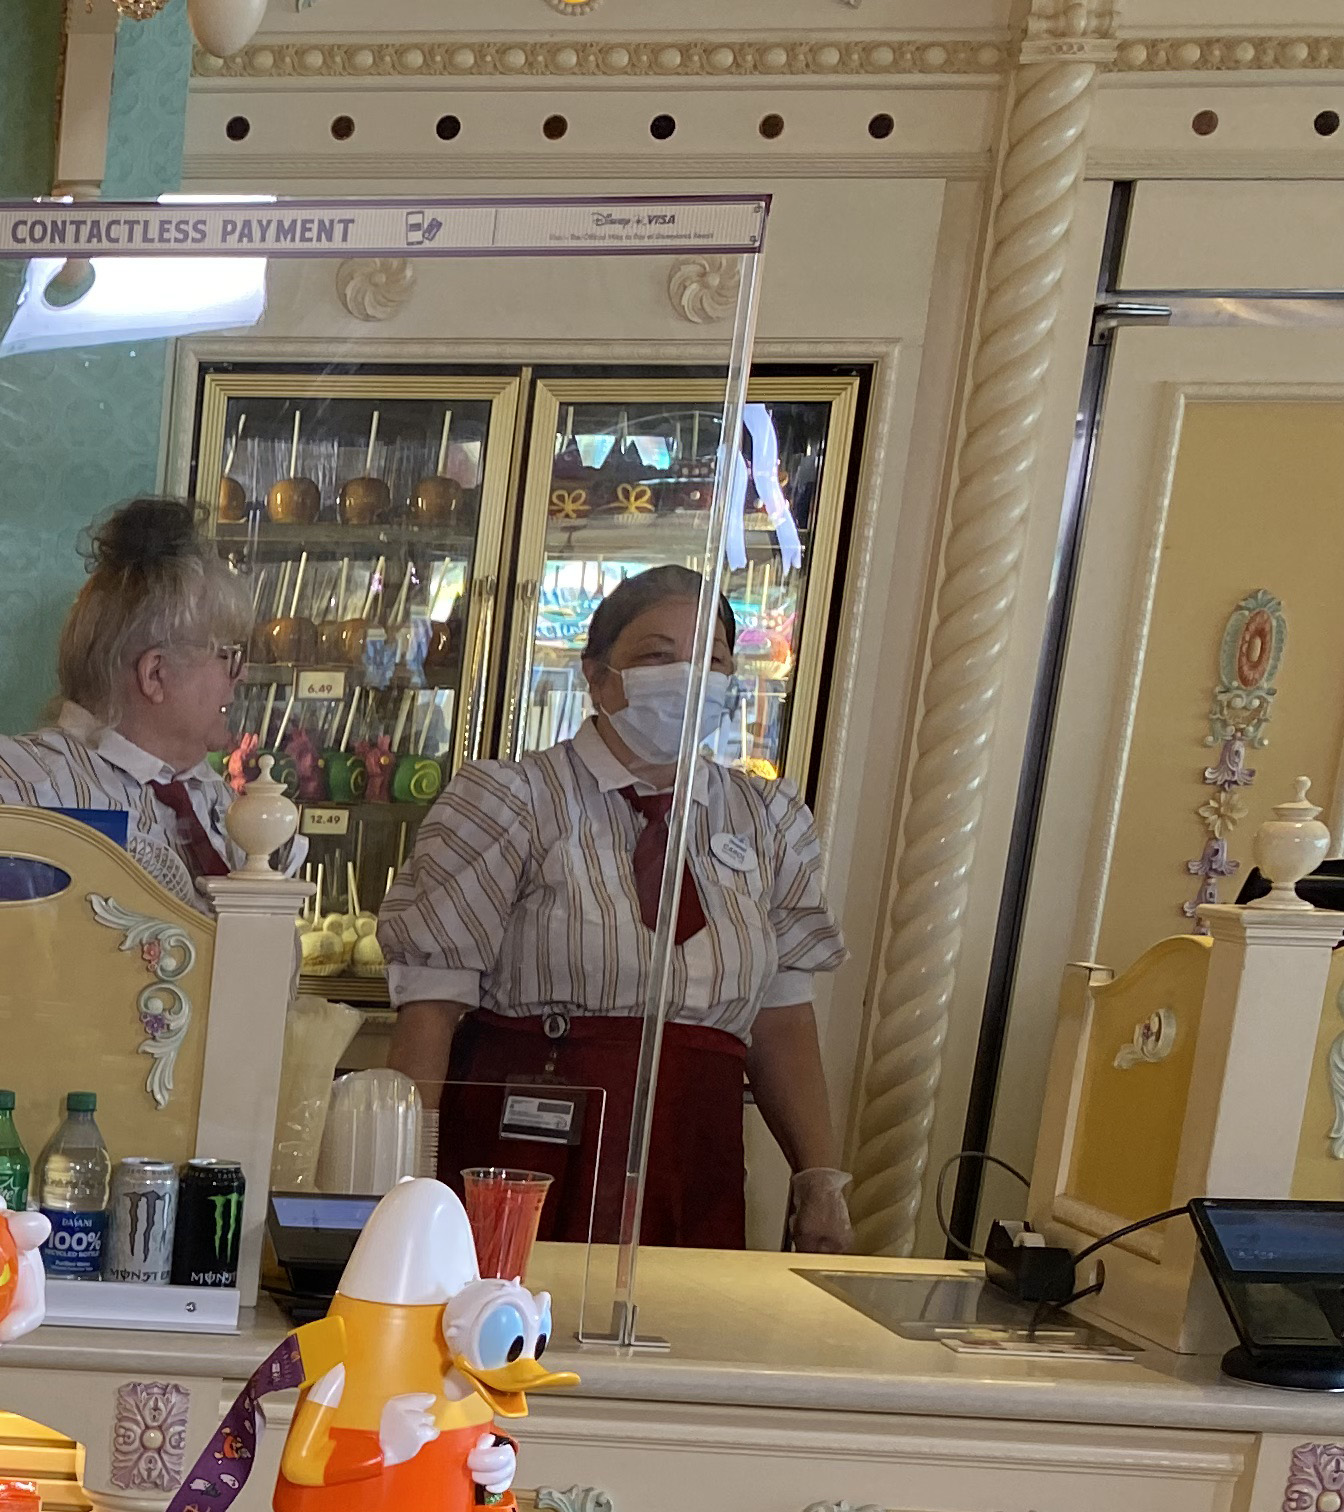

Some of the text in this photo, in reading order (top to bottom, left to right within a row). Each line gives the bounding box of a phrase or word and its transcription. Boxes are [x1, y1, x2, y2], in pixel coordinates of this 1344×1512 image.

[647, 214, 676, 225] VISA
[11, 218, 207, 245] CONTACTLESS
[220, 217, 356, 244] PAYMENT
[307, 684, 333, 694] 6.49
[310, 815, 341, 825] 12.49
[61, 1216, 93, 1228] DASANI
[48, 1231, 102, 1251] 100%
